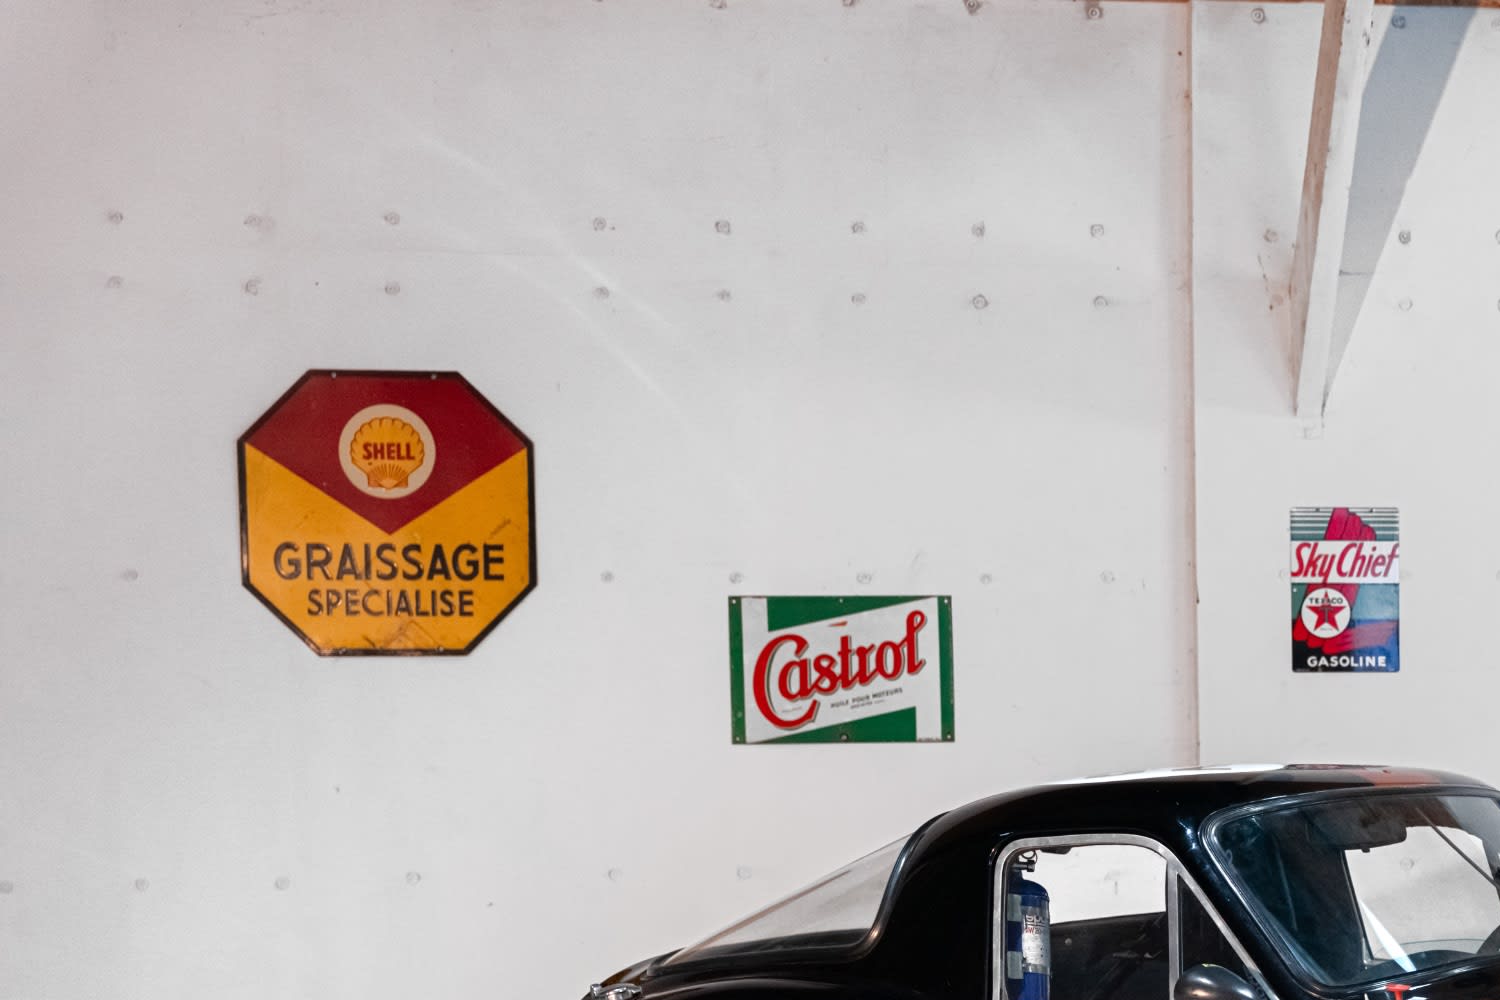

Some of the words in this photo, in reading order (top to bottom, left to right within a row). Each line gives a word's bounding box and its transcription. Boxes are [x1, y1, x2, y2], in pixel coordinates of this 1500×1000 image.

[362, 442, 416, 461] SHELL
[273, 541, 505, 582] GRAISSAGE
[1290, 542, 1336, 586] Sky
[1336, 542, 1400, 578] Chief
[307, 588, 475, 618] SPECIALISE
[752, 610, 928, 730] Castrol
[1307, 655, 1387, 668] GASOLINE
